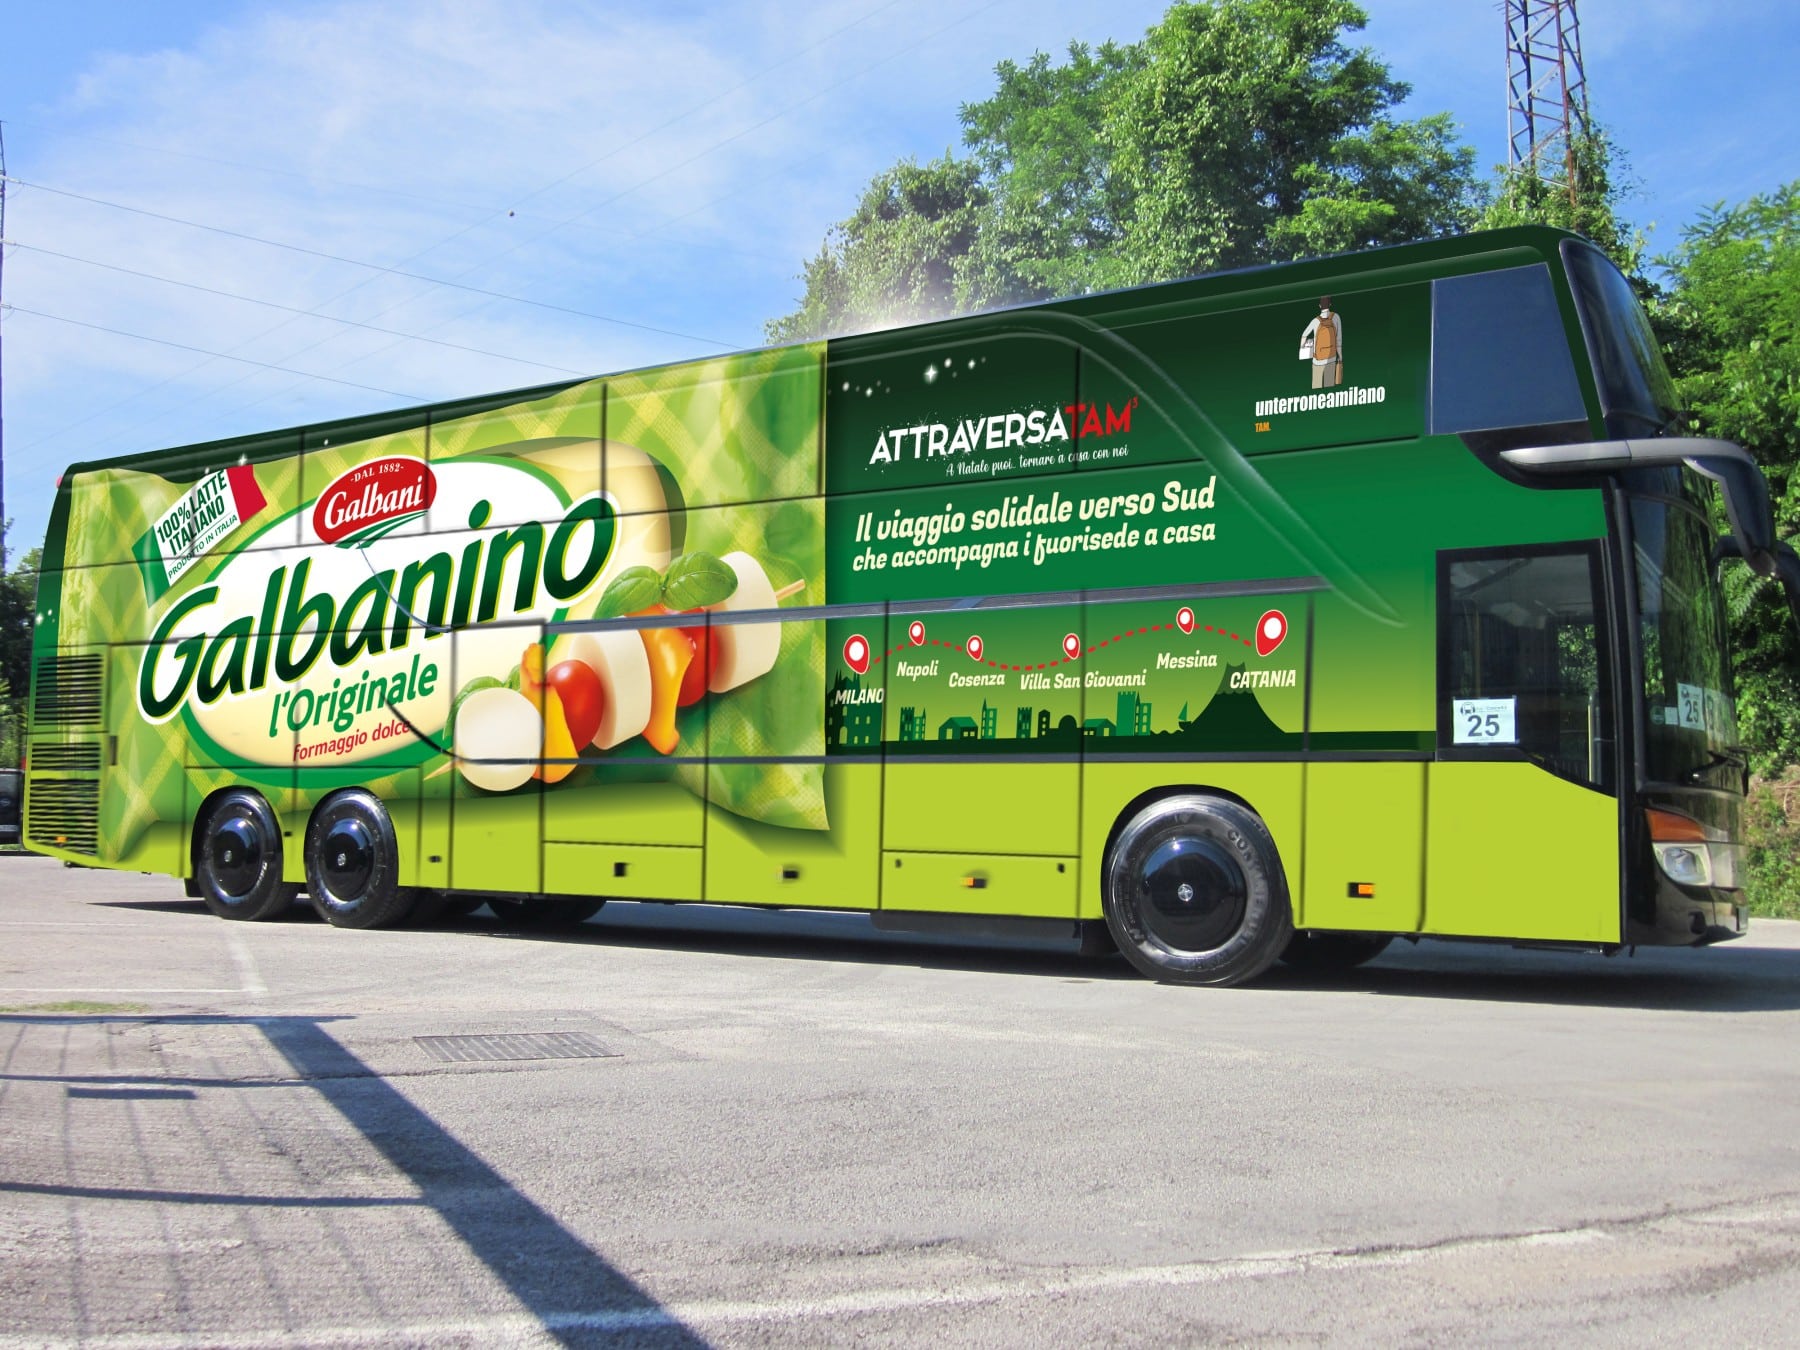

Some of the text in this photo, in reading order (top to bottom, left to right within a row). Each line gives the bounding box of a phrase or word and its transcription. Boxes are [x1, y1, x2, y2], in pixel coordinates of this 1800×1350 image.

[1255, 386, 1386, 417] unterroneamilano
[945, 463, 955, 477] A
[956, 459, 990, 476] Natale
[1019, 454, 1056, 468] tornare
[1057, 452, 1066, 464] a
[1068, 450, 1090, 463] casa
[1092, 446, 1110, 460] con
[1112, 444, 1129, 458] noi
[156, 468, 228, 544] 100% LATTE
[324, 475, 424, 531] Galbani
[855, 475, 1217, 547] Il viaggio solidale verso Sud
[168, 495, 226, 557] ITALIANO
[167, 514, 238, 579] PRODOTTO IN ITALIA
[852, 522, 1216, 572] che accompagna i fuorisede a casa
[140, 497, 617, 718] Galbanino
[896, 660, 939, 681] Napoli
[1156, 650, 1218, 670] Messina
[268, 653, 438, 738] l'Originale
[949, 672, 1005, 688] Cosenza
[1020, 669, 1147, 690] Villa San Giovanni
[1229, 669, 1297, 689] CATANIA
[835, 688, 885, 705] MILANO
[1685, 699, 1699, 723] 25
[293, 719, 411, 762] formaggio dolce
[1467, 714, 1500, 737] 25
